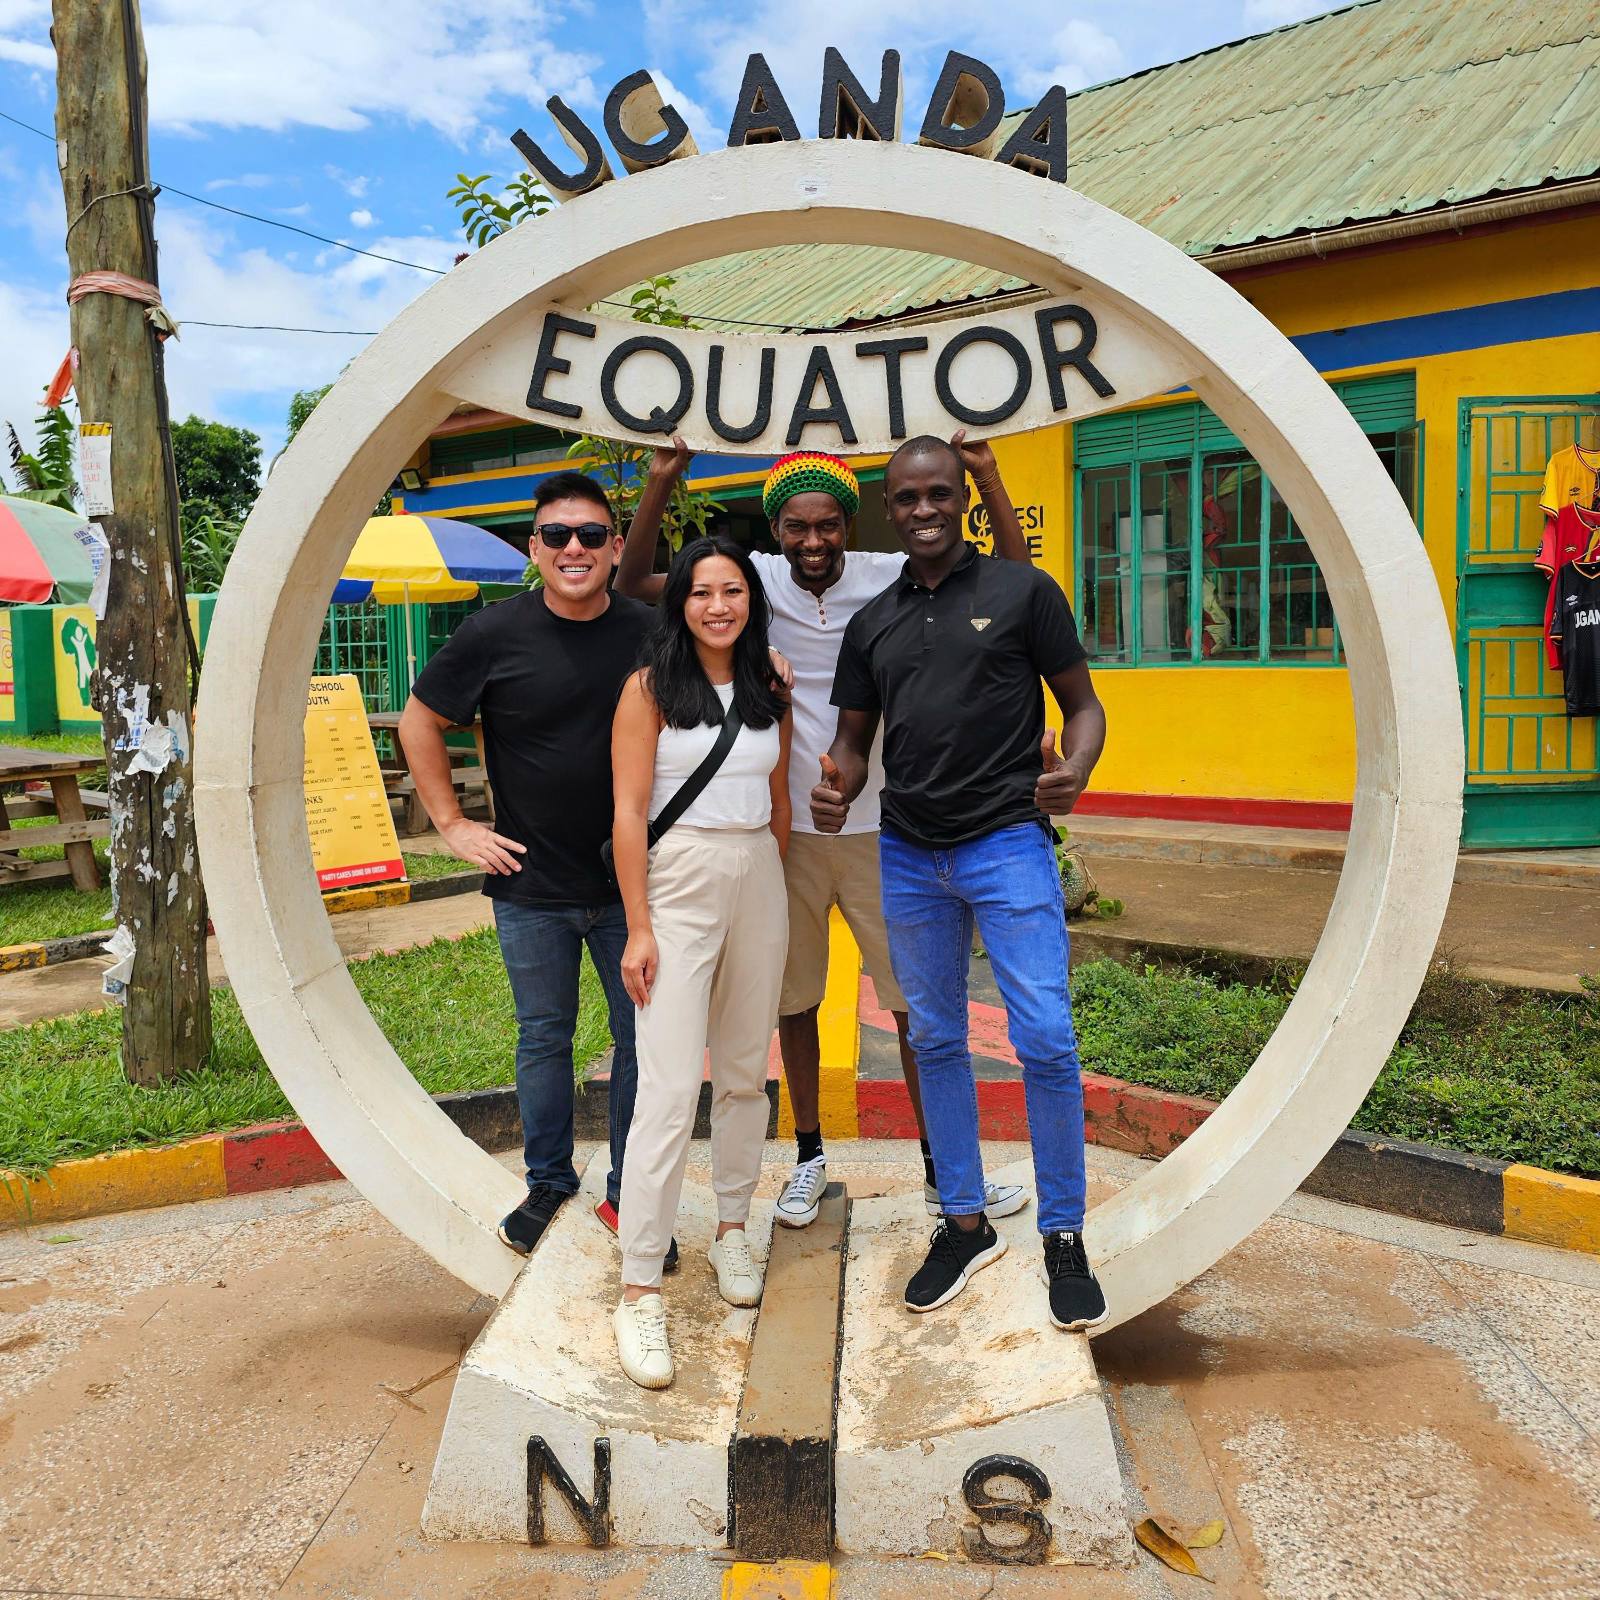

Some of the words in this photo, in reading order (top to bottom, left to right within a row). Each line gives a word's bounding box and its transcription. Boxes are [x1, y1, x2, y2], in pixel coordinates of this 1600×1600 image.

[511, 47, 1068, 192] UGANDA
[526, 304, 1117, 446] EQUATOR
[526, 1435, 611, 1547] N
[961, 1453, 1053, 1566] S
